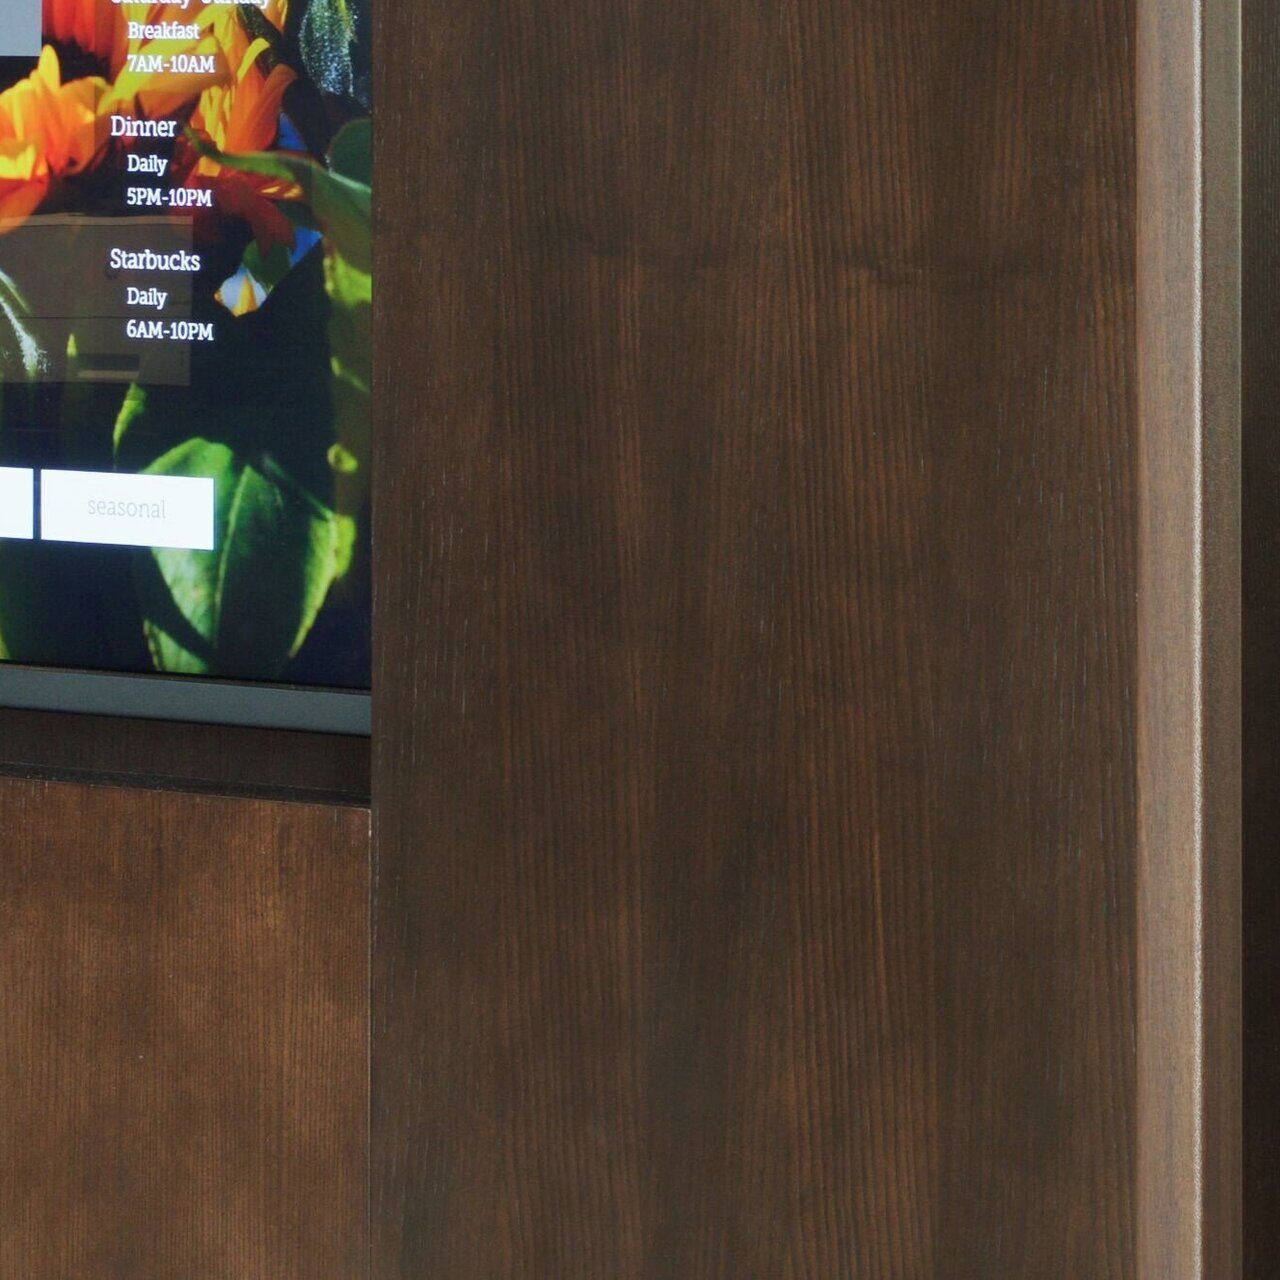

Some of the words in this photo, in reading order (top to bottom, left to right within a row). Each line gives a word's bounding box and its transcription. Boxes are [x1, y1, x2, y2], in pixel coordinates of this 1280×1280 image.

[128, 22, 200, 40] Breakfast
[127, 54, 215, 73] 7AM-10AM
[111, 116, 176, 137] Dinner
[128, 155, 168, 175] Daily
[126, 188, 212, 207] 5PM-10PM
[110, 248, 200, 271] Starbucks
[127, 287, 168, 309] Daily
[126, 320, 214, 341] 6AM-10PM
[87, 496, 167, 519] seasonal
